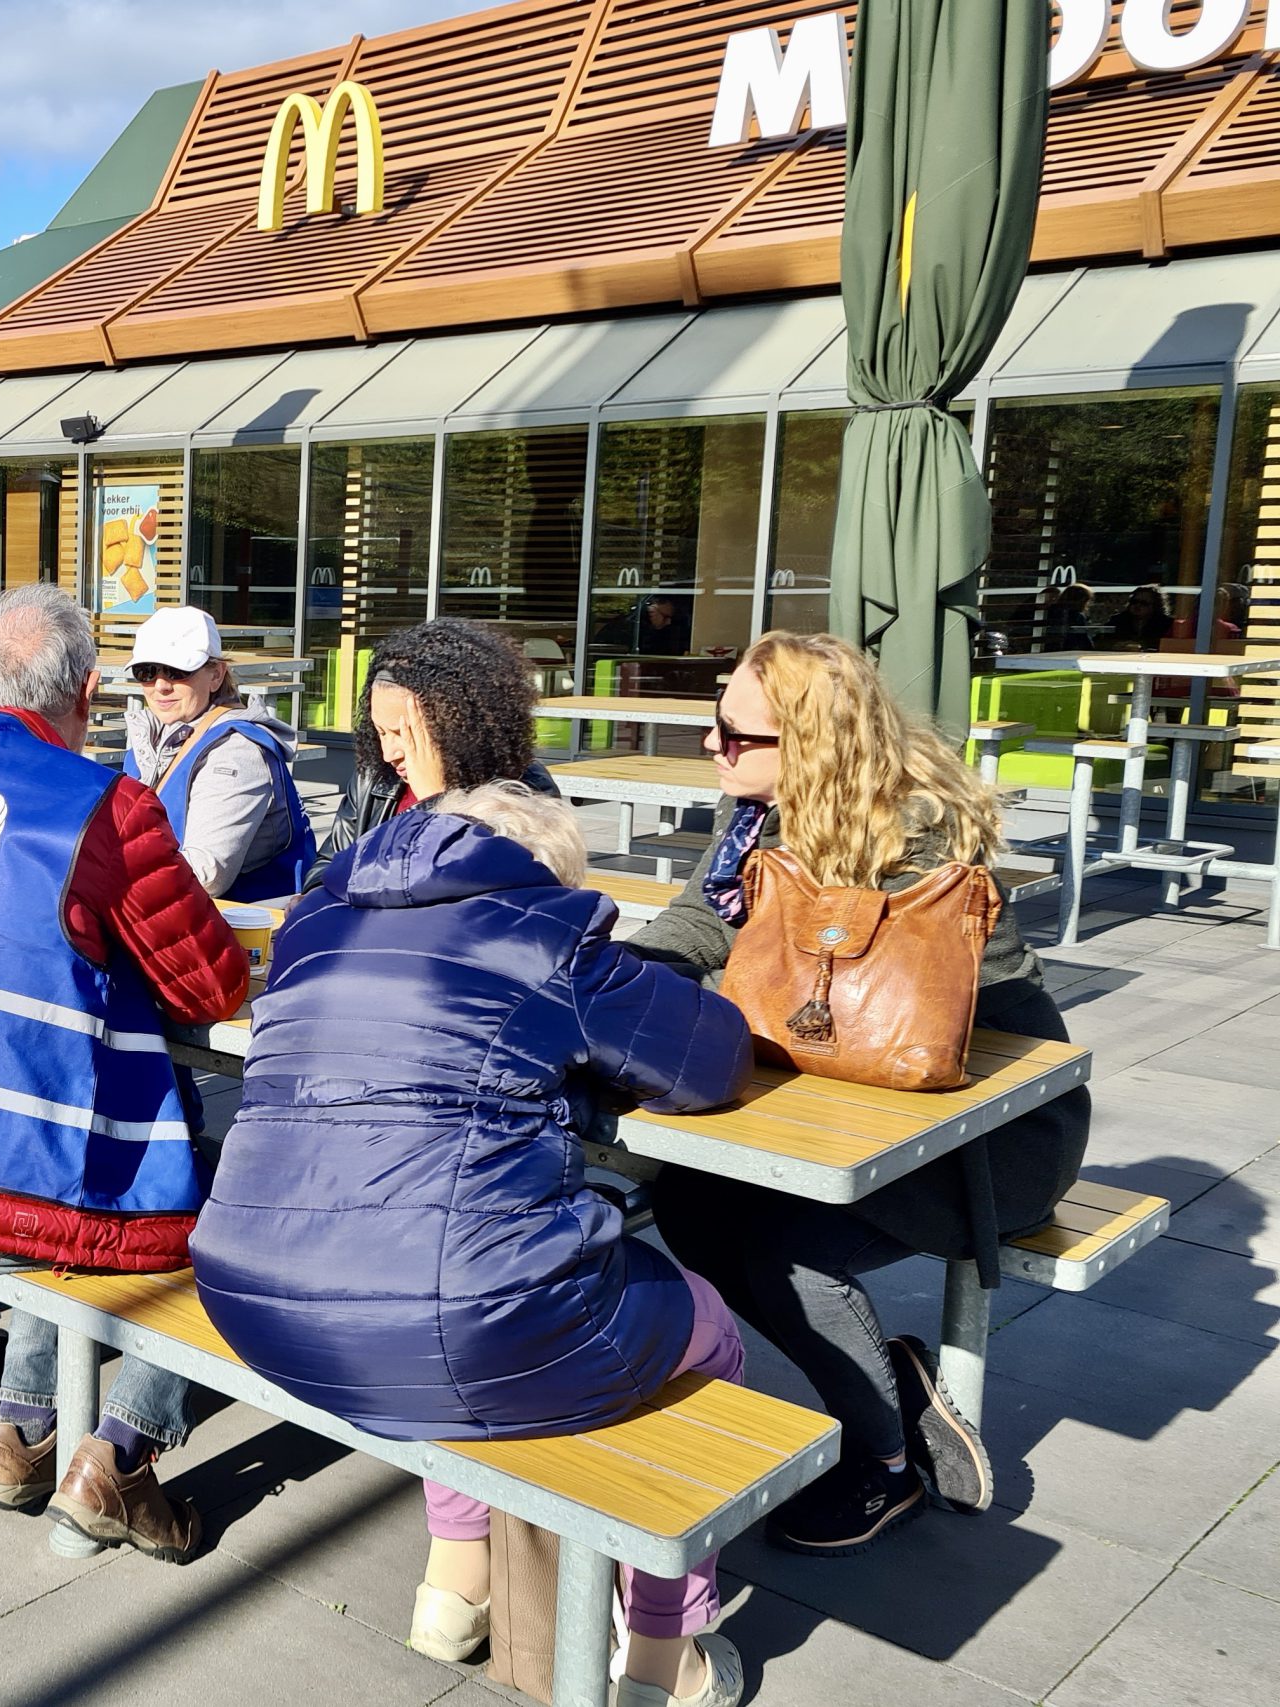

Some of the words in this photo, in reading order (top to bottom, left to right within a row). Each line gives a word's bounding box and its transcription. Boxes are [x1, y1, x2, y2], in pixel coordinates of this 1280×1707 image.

[102, 494, 130, 504] Lekker
[101, 507, 120, 515] voor
[121, 505, 140, 516] erbij
